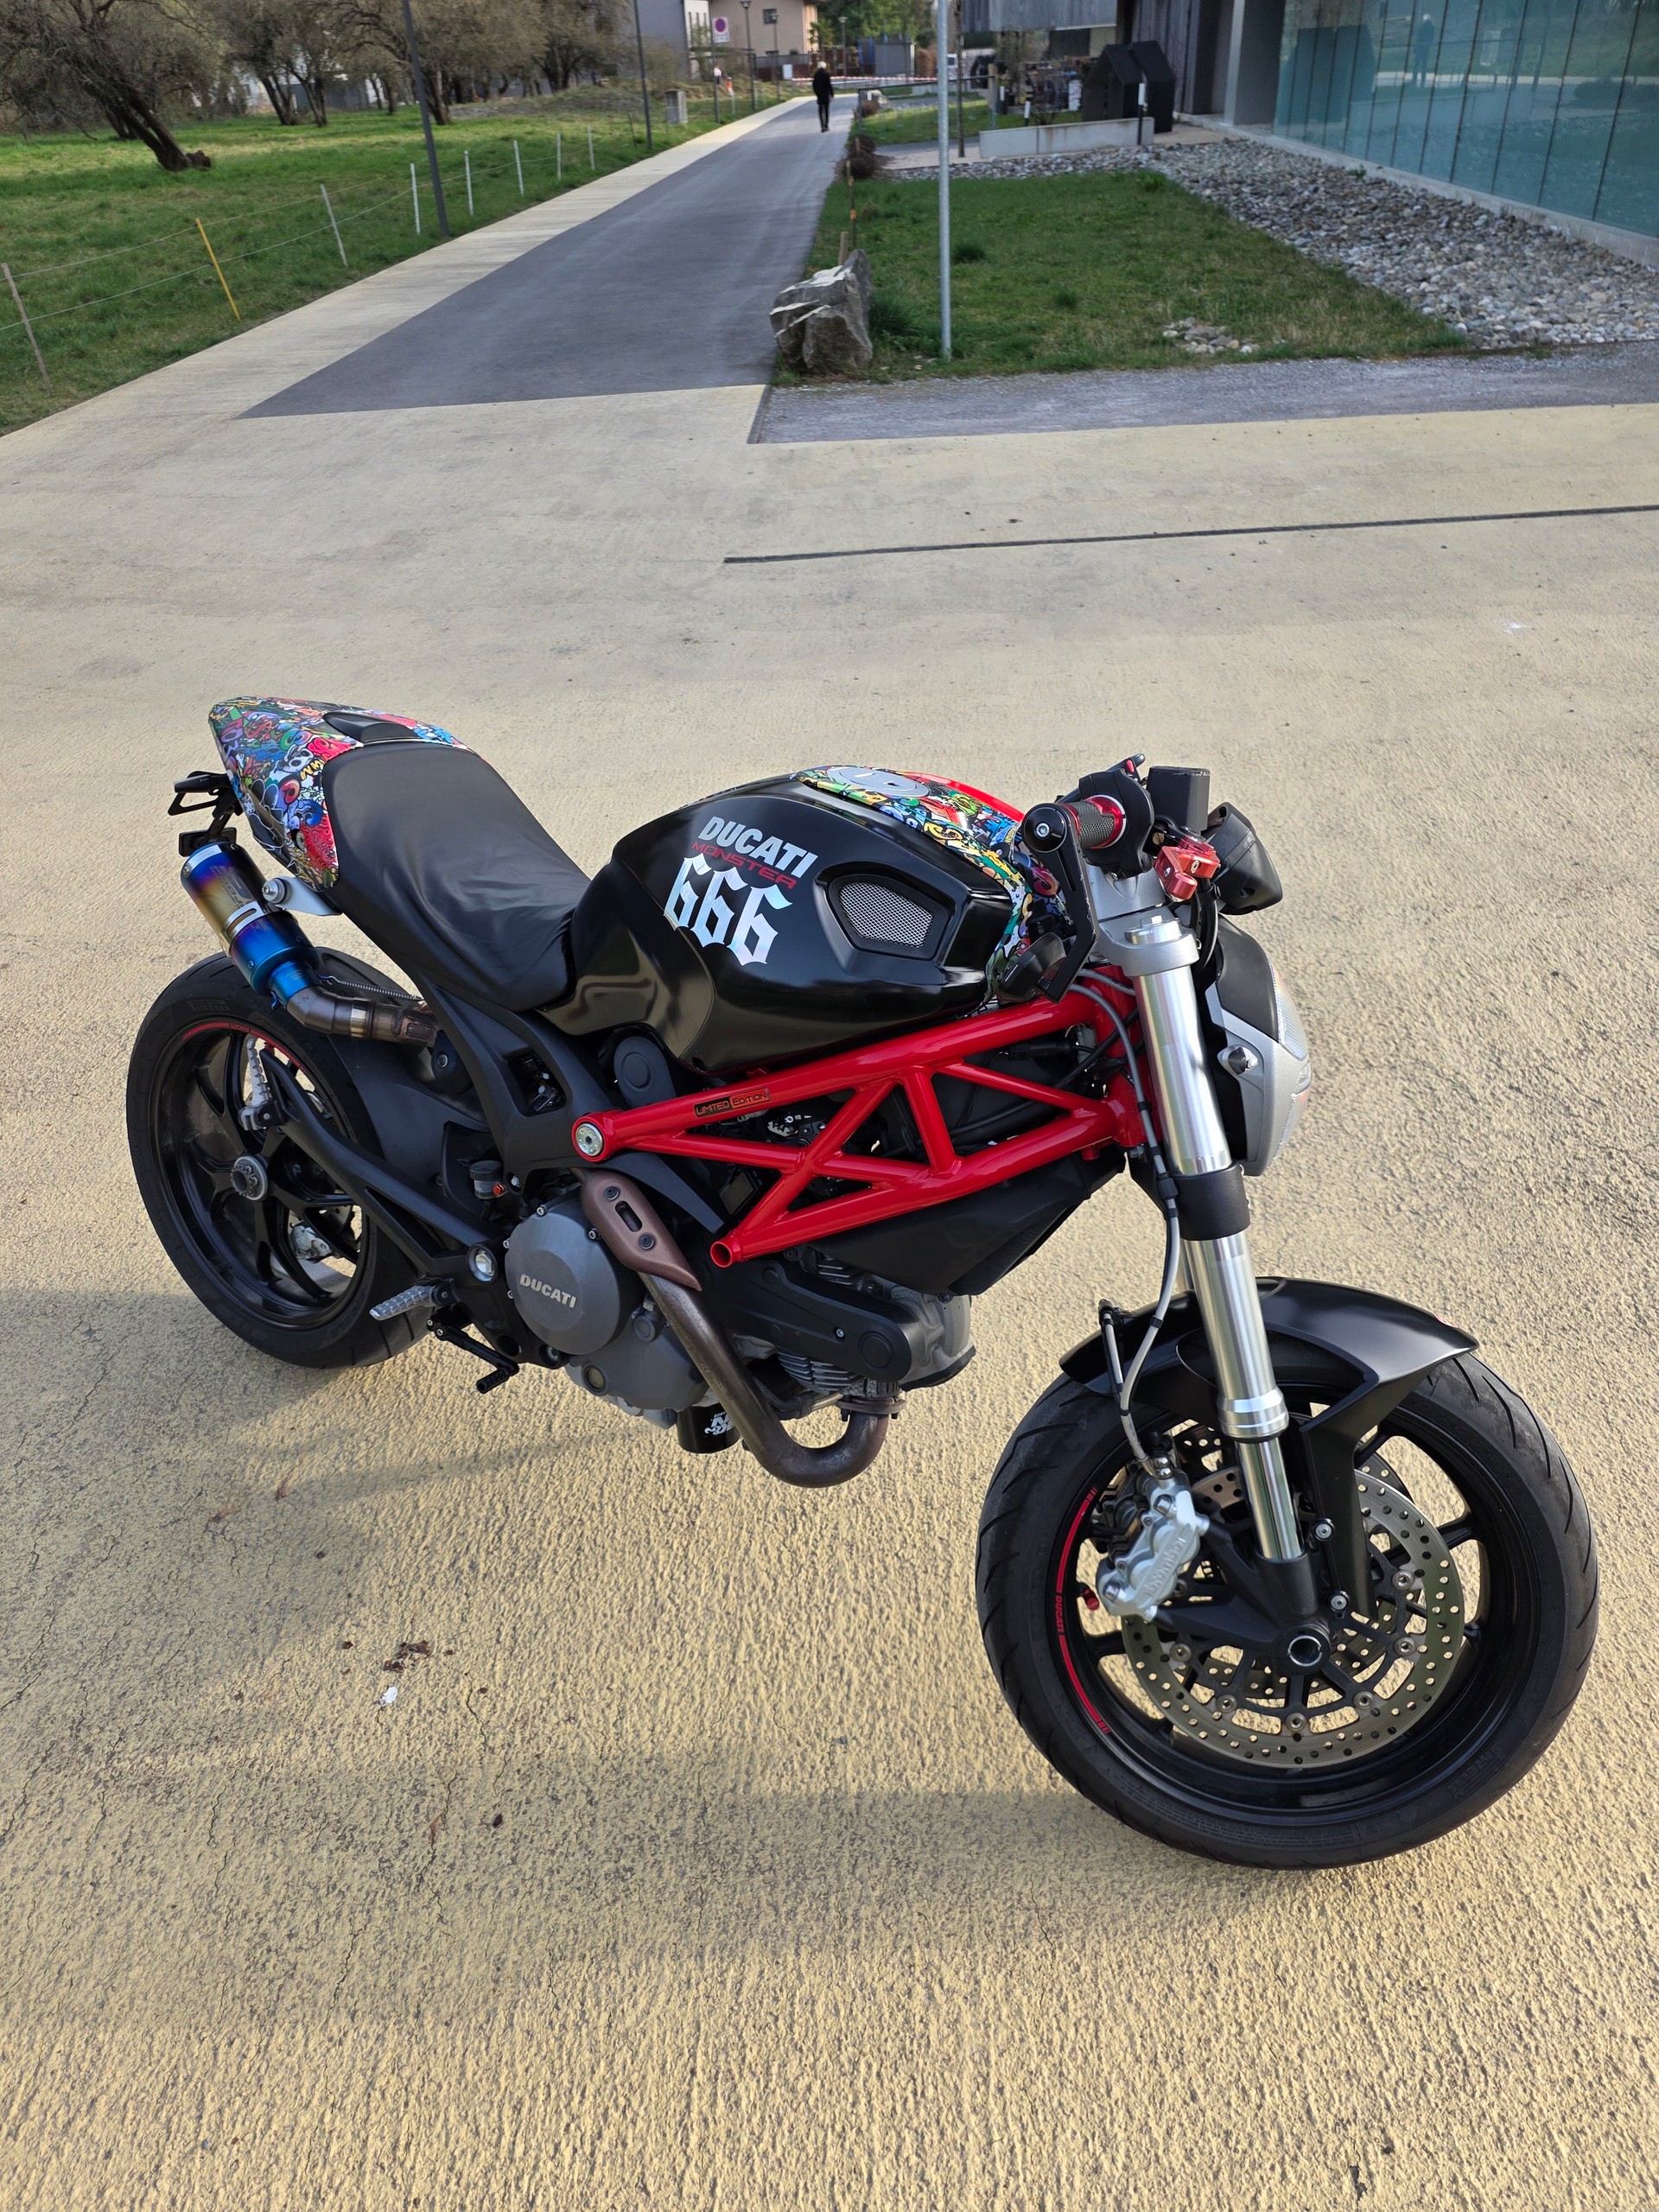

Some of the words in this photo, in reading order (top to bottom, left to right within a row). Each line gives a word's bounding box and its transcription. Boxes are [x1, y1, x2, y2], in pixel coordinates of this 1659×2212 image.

[691, 841, 799, 890] MONSTER
[698, 817, 818, 879] DUCATI
[664, 853, 793, 966] 666
[696, 1100, 730, 1116] LIMITED
[732, 1090, 767, 1106] EDITION
[519, 1273, 577, 1309] DUCATI
[1055, 1595, 1065, 1632] DUCATI
